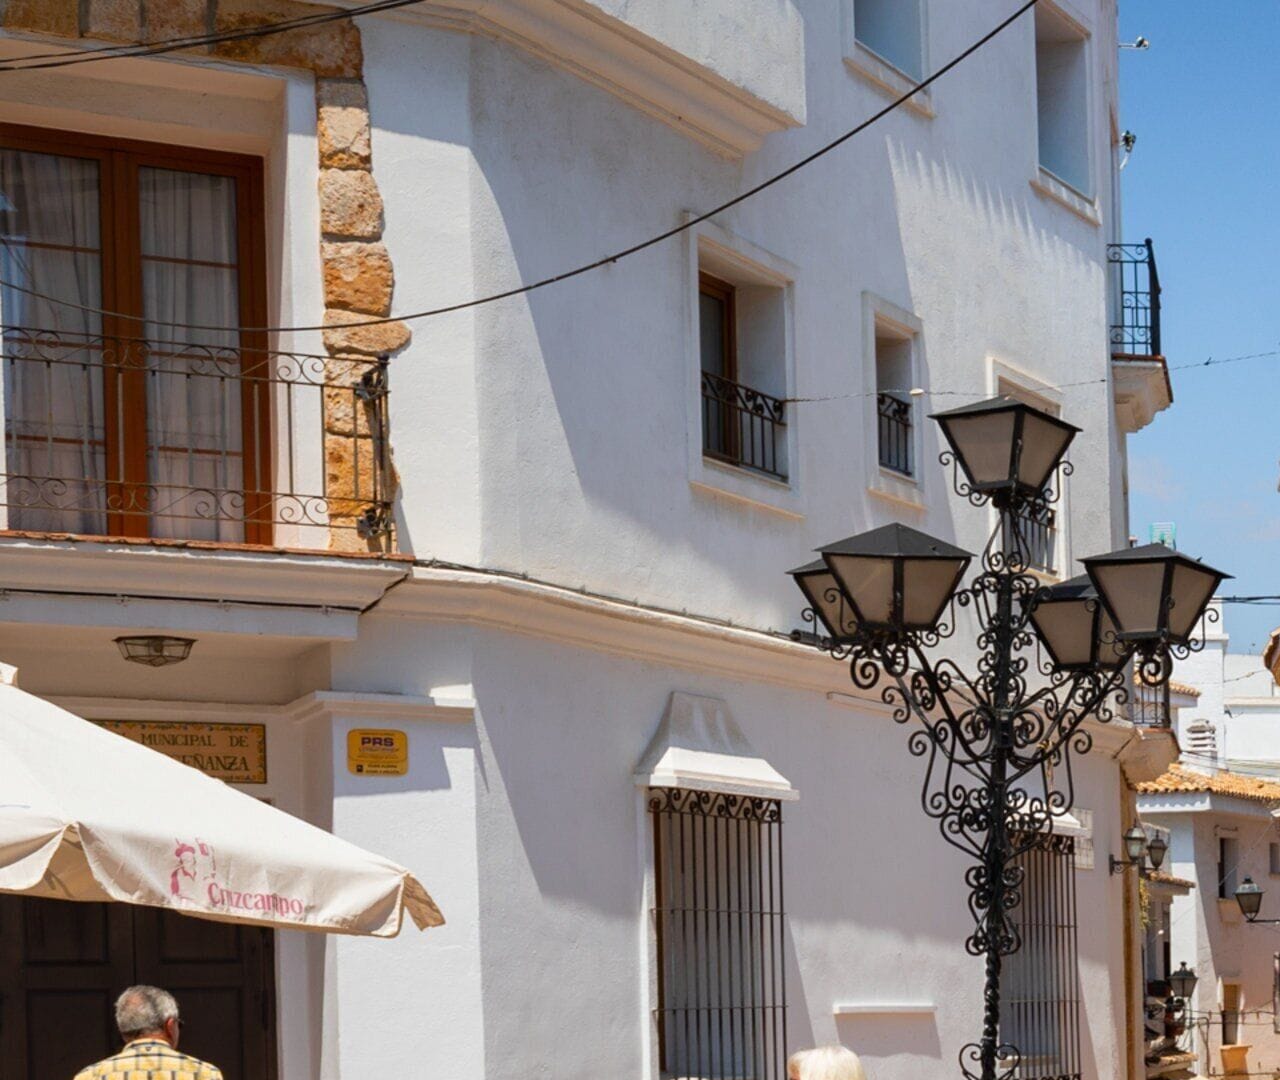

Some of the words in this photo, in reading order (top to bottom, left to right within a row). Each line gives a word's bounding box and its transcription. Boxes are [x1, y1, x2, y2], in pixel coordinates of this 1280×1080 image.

[141, 734, 216, 747] MUNICIPAL
[229, 735, 249, 748] DE
[361, 737, 394, 747] PRS
[176, 754, 250, 771] EÑANZA
